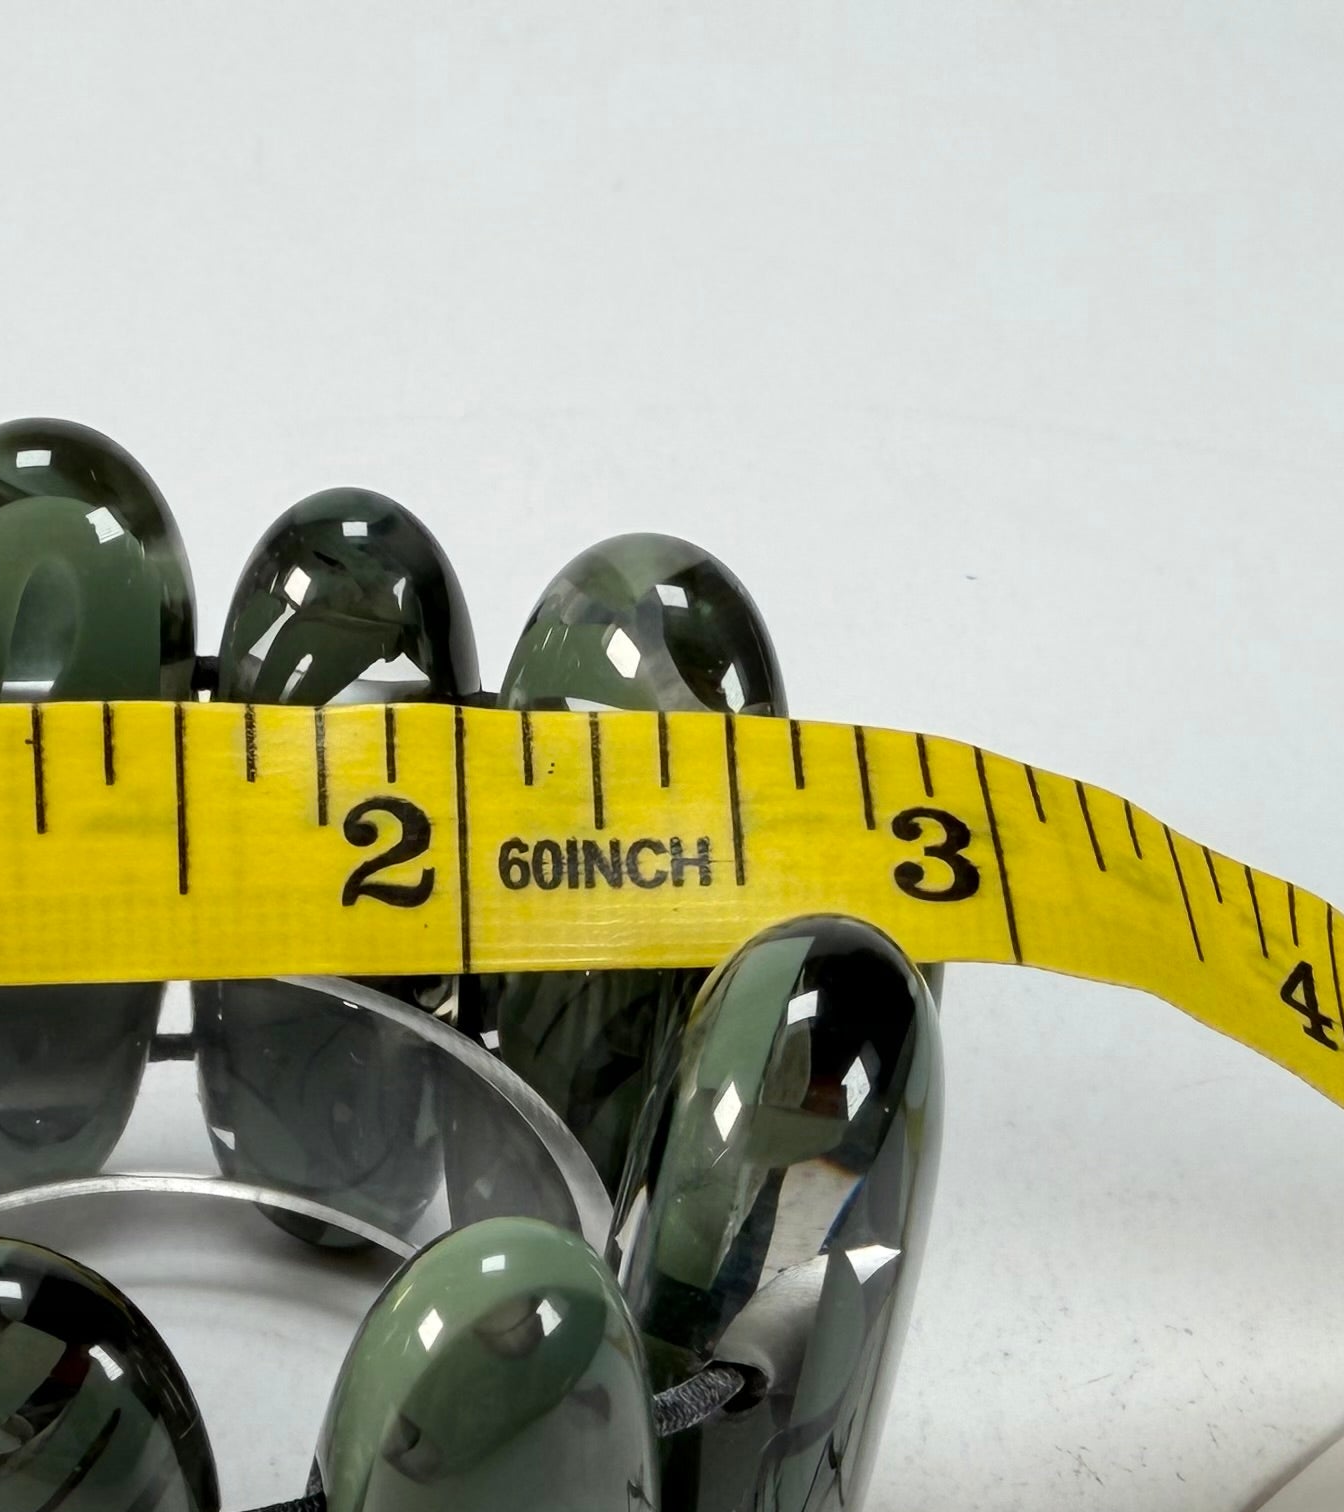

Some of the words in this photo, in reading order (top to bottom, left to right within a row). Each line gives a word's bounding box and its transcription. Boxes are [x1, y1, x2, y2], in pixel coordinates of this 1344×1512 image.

[341, 796, 435, 908] 2
[498, 836, 713, 891] 60INCH
[891, 806, 981, 902] 3
[1280, 961, 1339, 1052] 4
